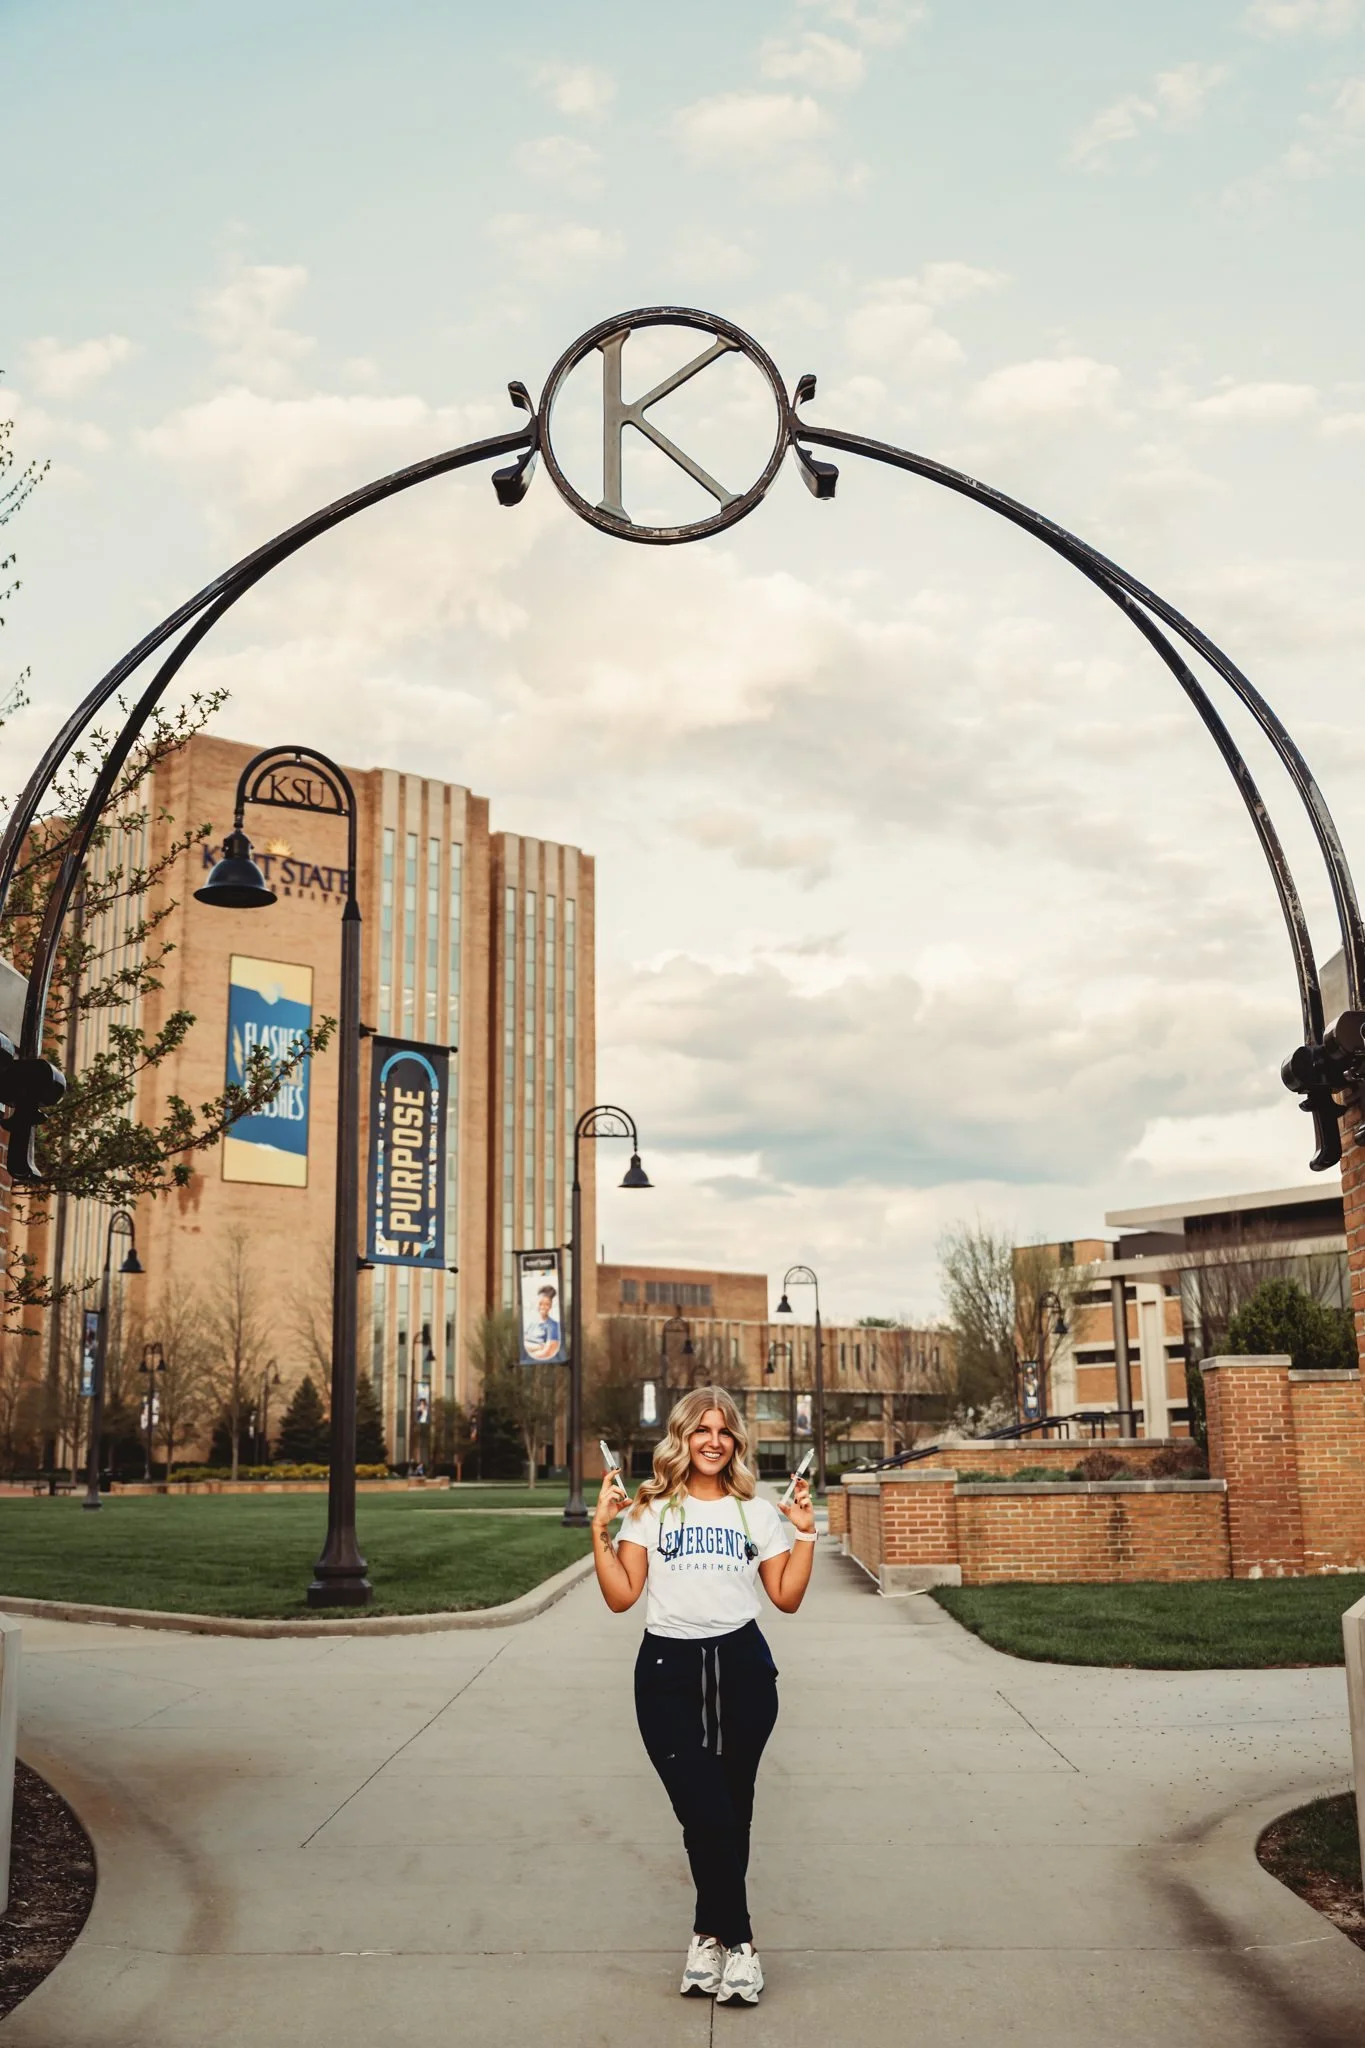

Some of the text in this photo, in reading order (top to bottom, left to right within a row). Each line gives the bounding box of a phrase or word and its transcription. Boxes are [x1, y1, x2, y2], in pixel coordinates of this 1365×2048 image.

[595, 327, 744, 525] K
[269, 774, 326, 807] KSU
[202, 843, 276, 881] KT
[389, 1087, 425, 1233] PURPOSE
[671, 1563, 745, 1573] DEPARTMENT
